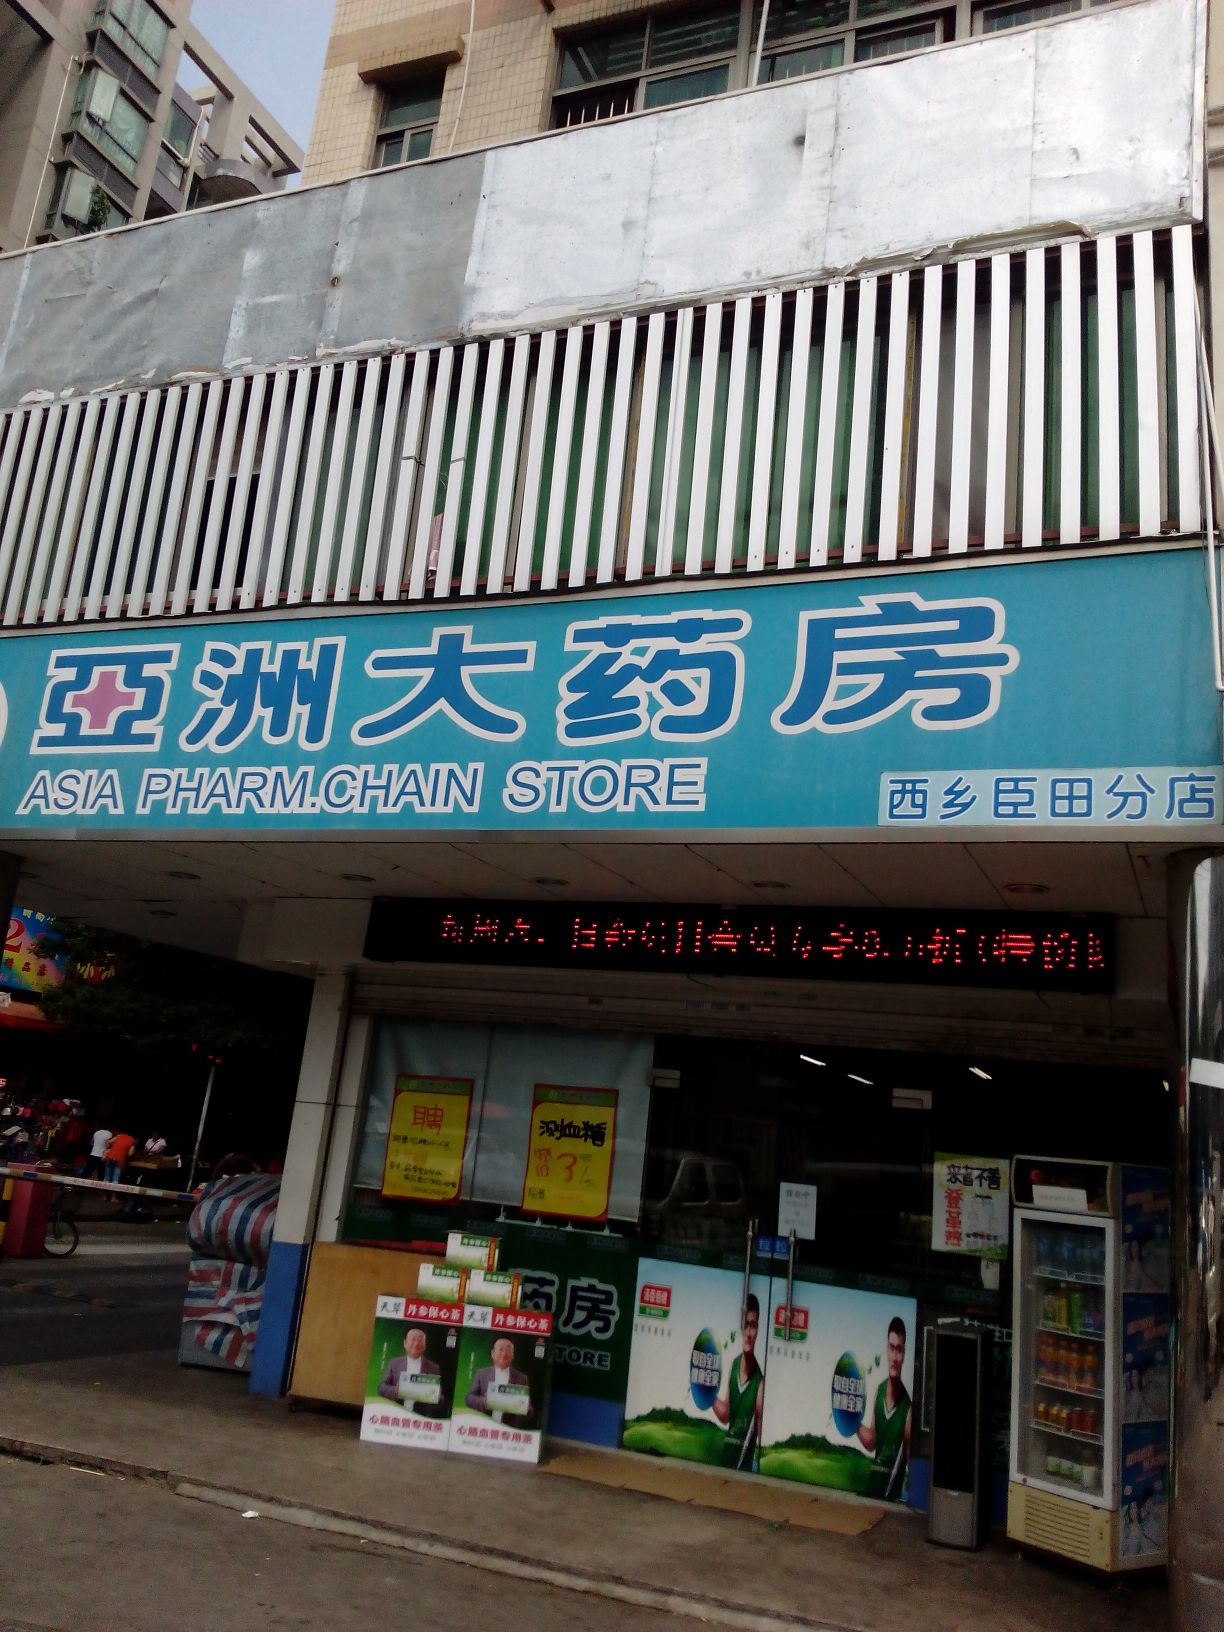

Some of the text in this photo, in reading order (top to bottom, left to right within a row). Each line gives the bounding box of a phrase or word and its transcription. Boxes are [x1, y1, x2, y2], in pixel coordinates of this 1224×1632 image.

[16, 757, 709, 814] ASIA PHARM.CHAIN STORE
[887, 770, 1217, 822] 西乡臣田分店
[411, 1104, 445, 1136] 聘
[368, 1414, 444, 1433] 心脑血管专用茶
[456, 1425, 534, 1445] 心脑血管专用茶
